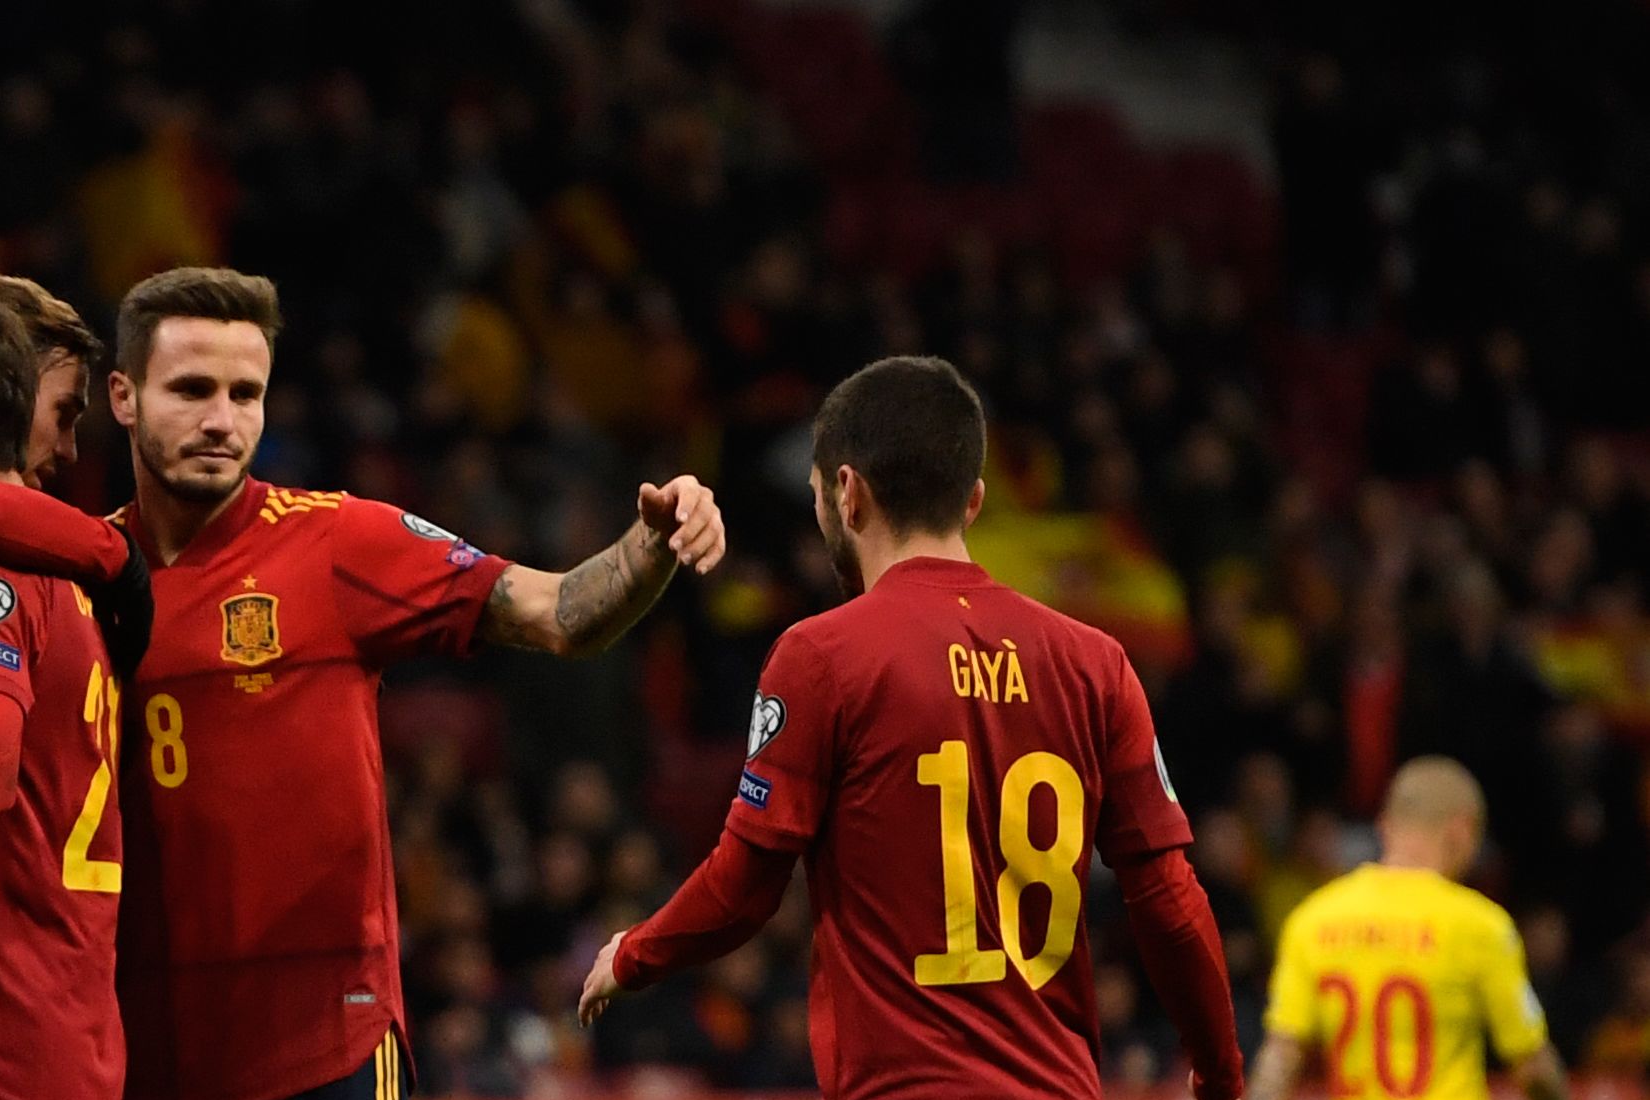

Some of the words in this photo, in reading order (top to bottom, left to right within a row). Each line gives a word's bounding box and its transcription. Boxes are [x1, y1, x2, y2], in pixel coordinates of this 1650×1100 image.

[948, 639, 1029, 703] GAYÀ
[145, 693, 188, 788] 8
[914, 740, 1084, 991] 18
[1317, 972, 1434, 1100] 20
